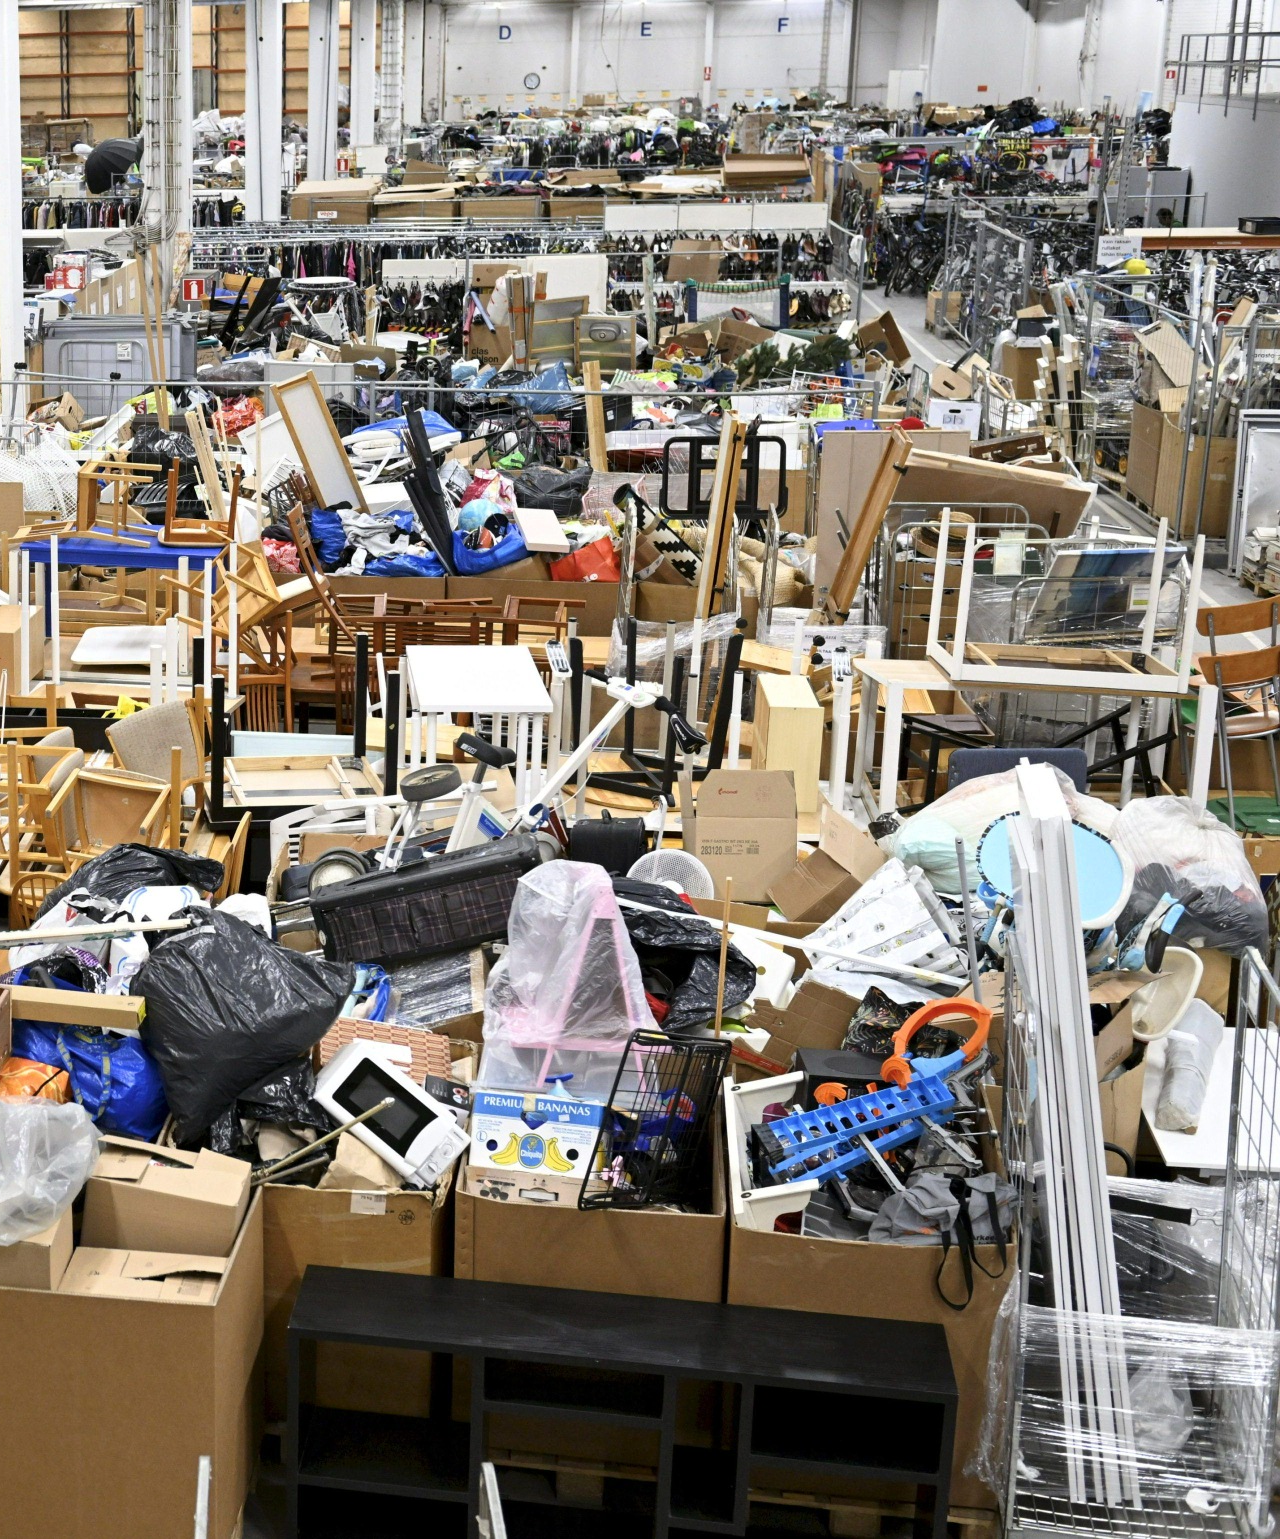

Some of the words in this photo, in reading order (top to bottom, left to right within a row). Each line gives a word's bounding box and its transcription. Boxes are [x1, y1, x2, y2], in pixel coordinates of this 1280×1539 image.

[498, 25, 512, 40] D
[640, 21, 652, 37] E
[777, 17, 789, 33] F
[471, 347, 489, 355] clas
[700, 845, 723, 856] 283120
[537, 1101, 592, 1117] BANANAS
[520, 1149, 543, 1161] Chiquita
